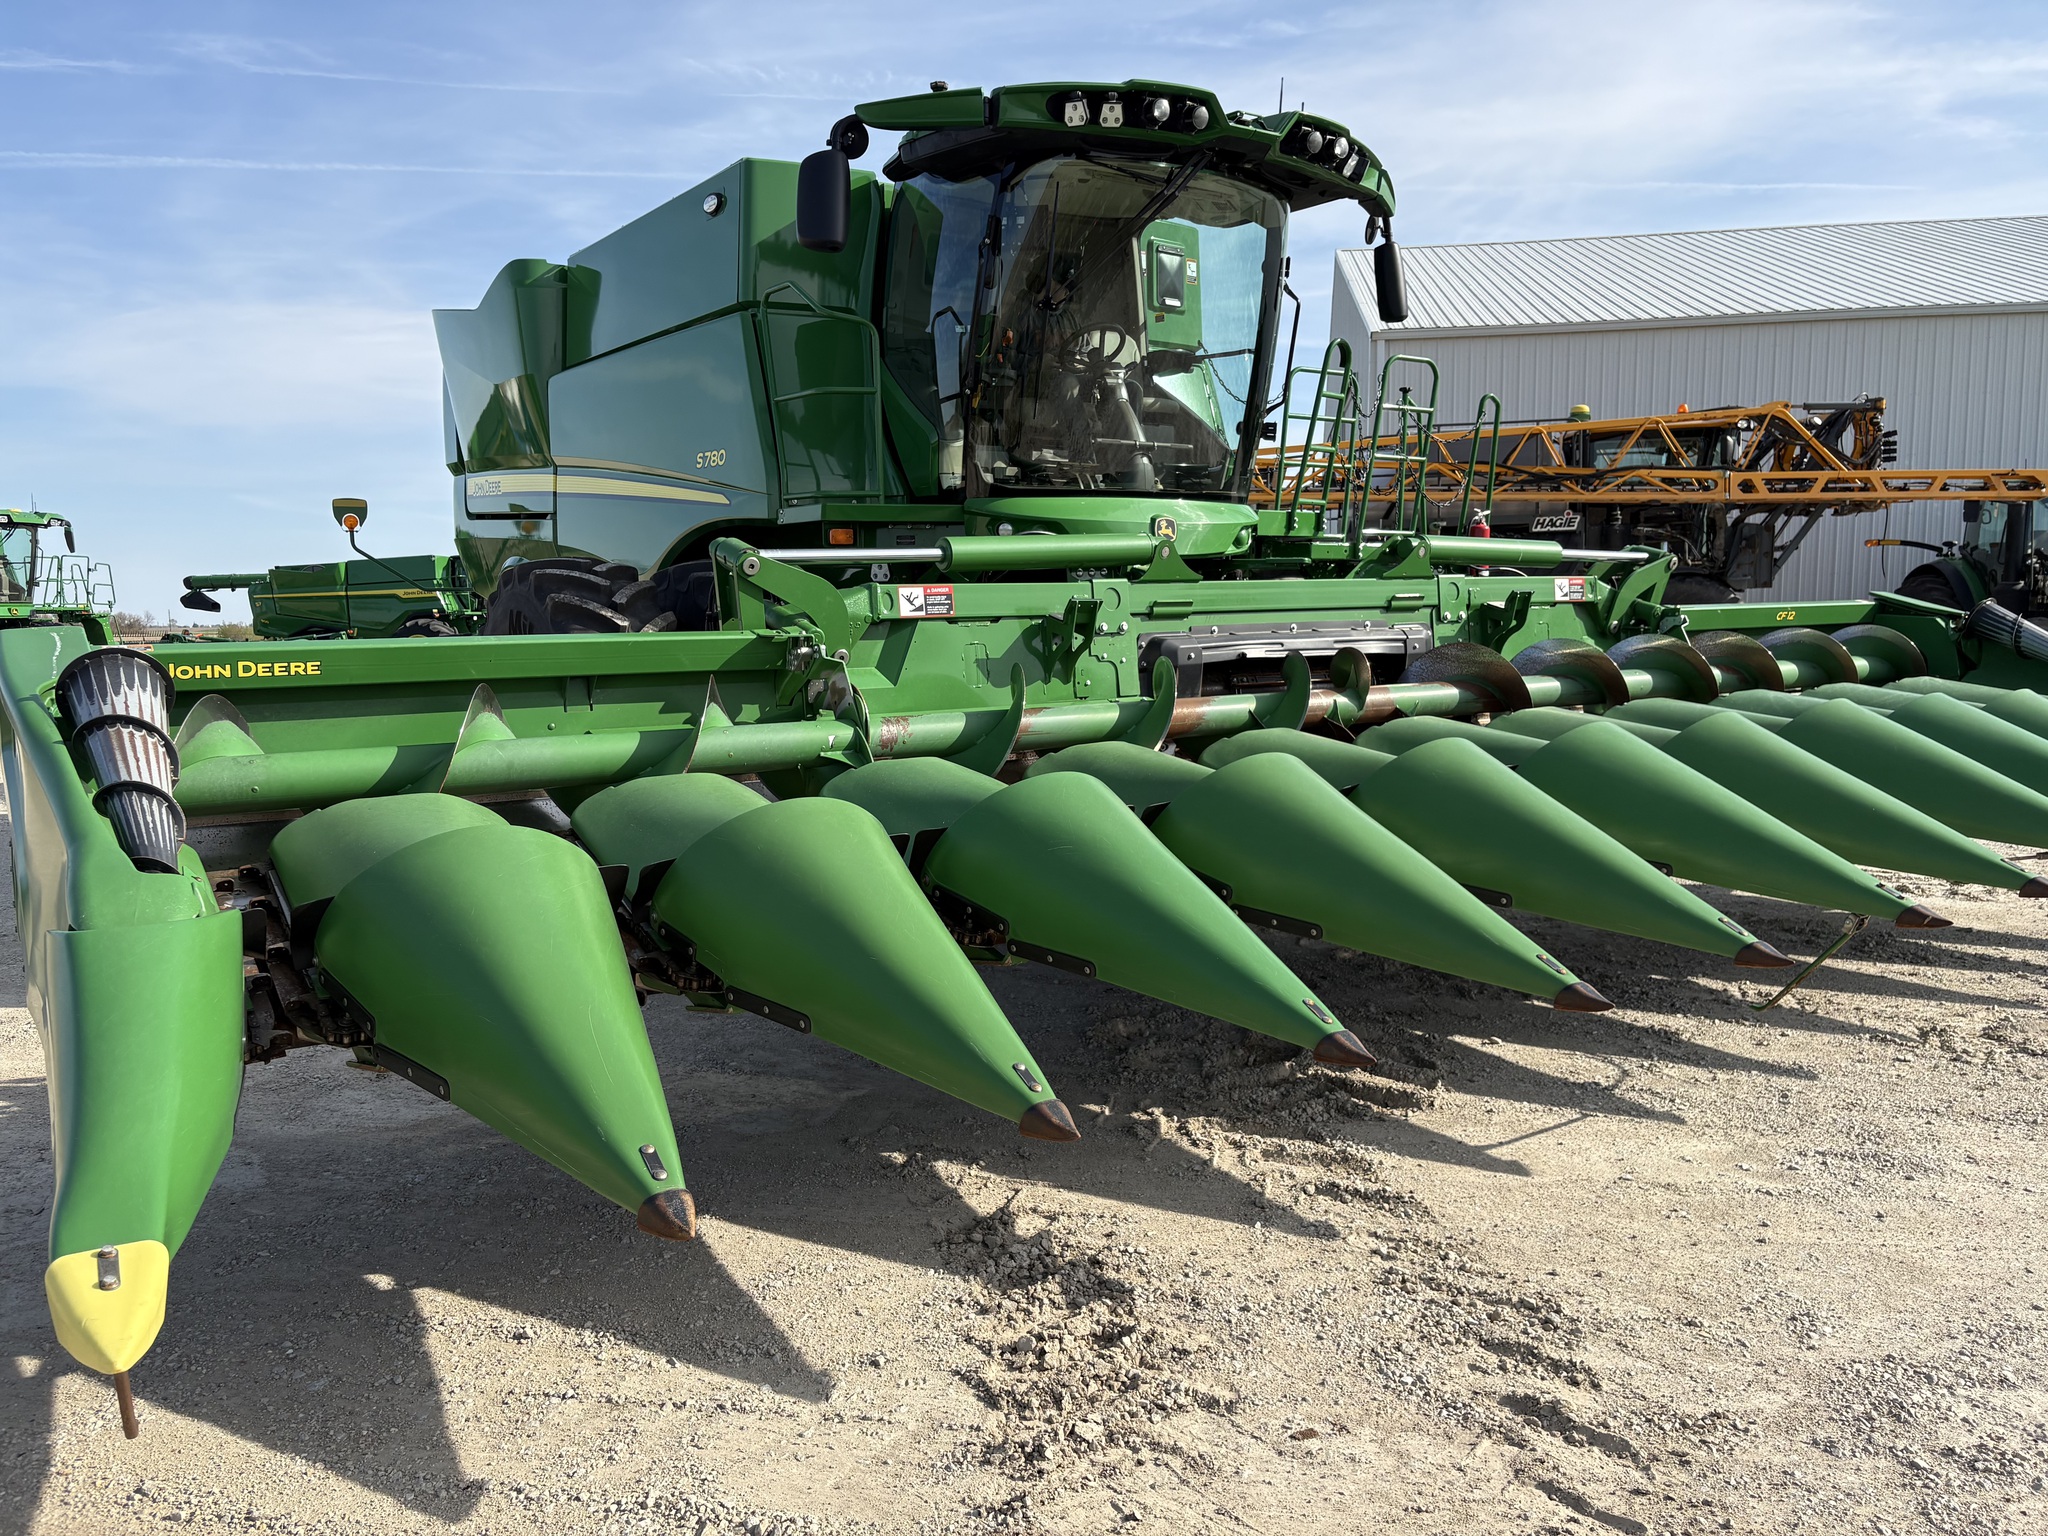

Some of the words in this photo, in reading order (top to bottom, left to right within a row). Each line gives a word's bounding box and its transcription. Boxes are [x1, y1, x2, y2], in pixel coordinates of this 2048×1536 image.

[696, 449, 726, 469] S780
[473, 481, 485, 495] JOHN
[485, 479, 502, 494] DEERE
[1533, 510, 1579, 530] HAGIE
[237, 660, 321, 678] DEERE
